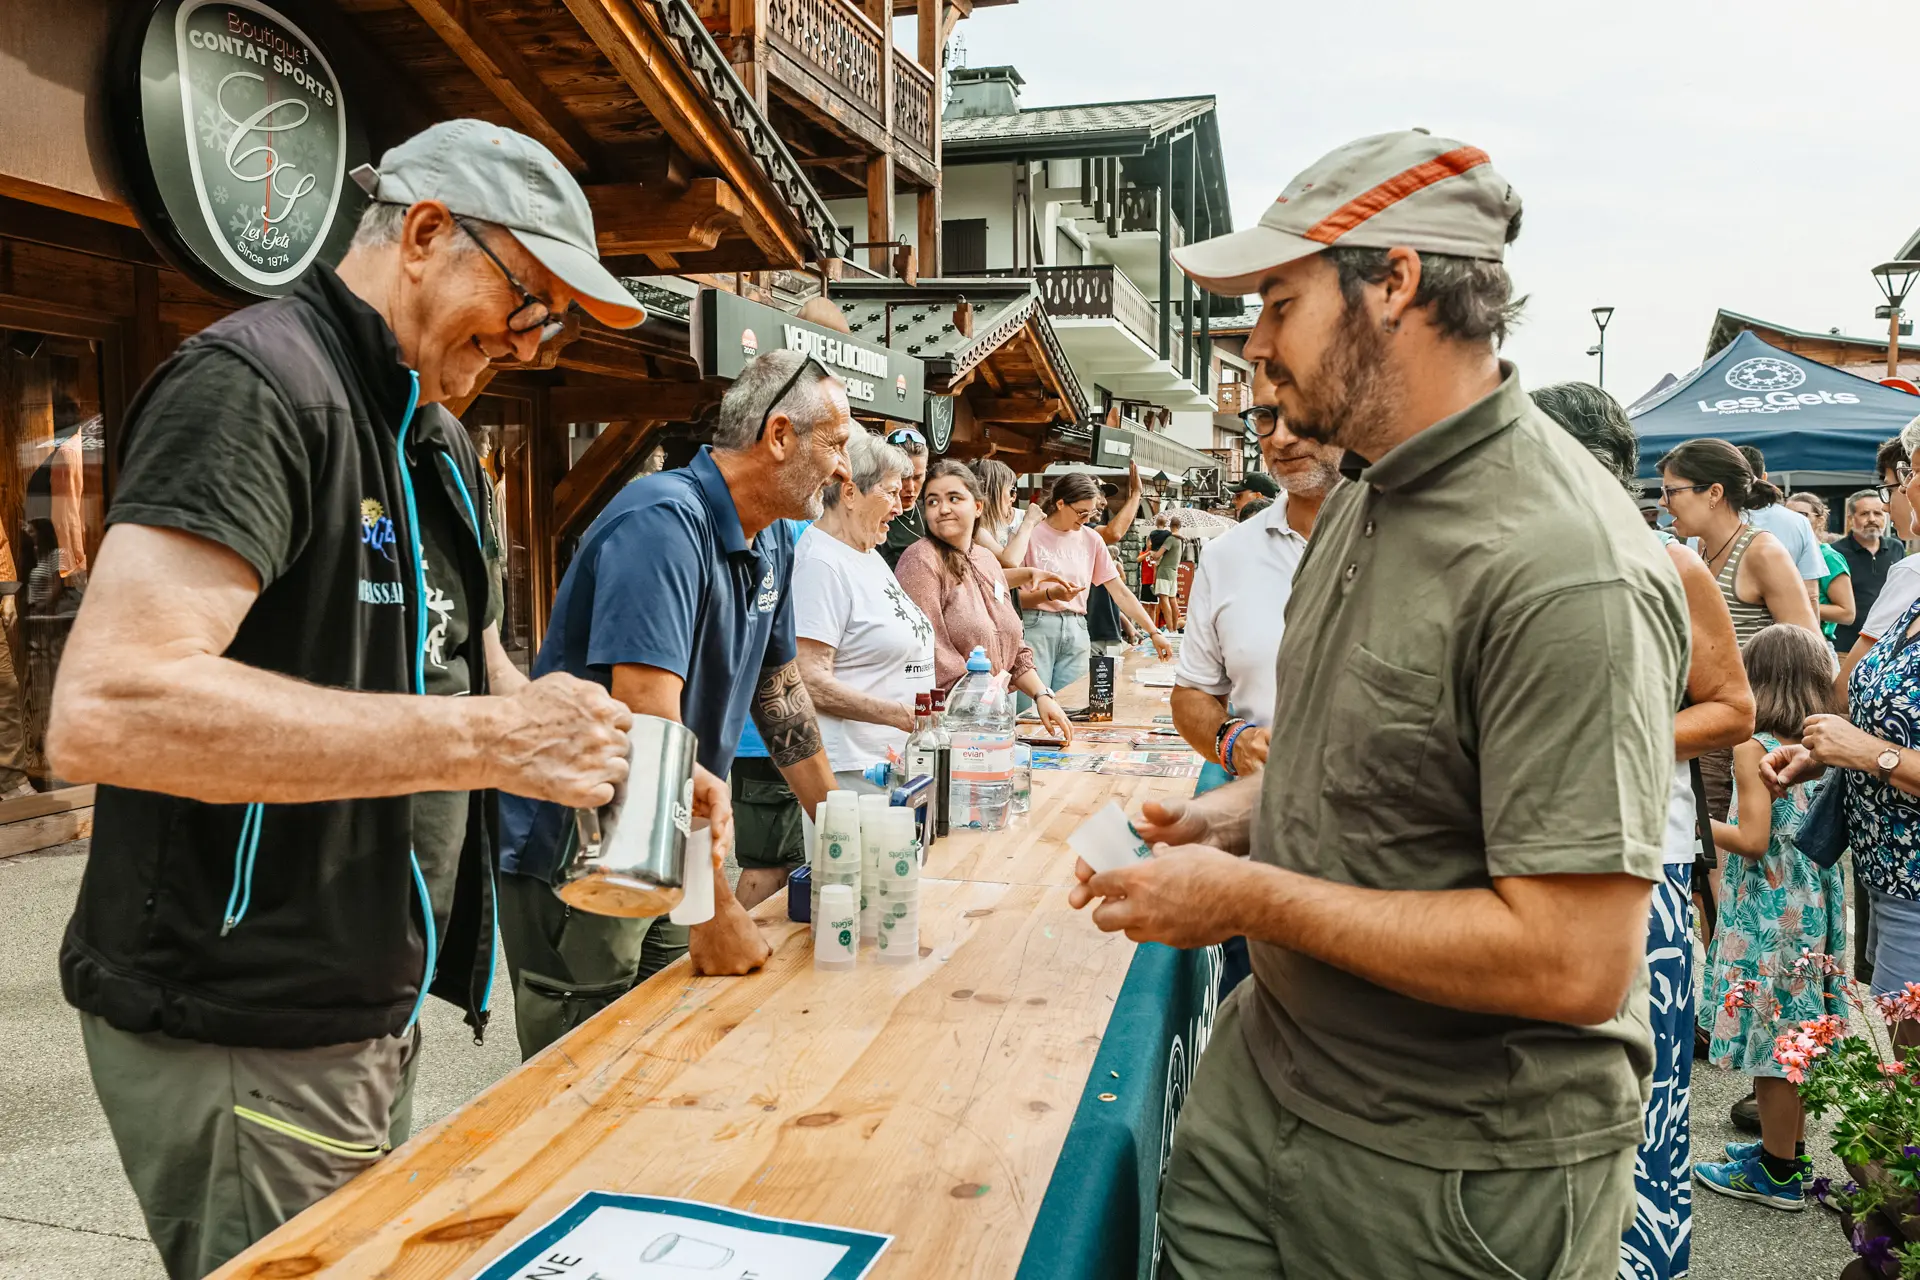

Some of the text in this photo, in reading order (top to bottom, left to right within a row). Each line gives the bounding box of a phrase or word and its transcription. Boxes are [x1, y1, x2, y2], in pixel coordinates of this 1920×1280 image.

[227, 11, 304, 65] Boutique
[189, 29, 334, 107] CONTAT SPORTS
[240, 219, 290, 250] Les Gets
[237, 241, 290, 267] Since 1974
[836, 340, 888, 379] LOCATION
[1697, 390, 1861, 413] Les Gets
